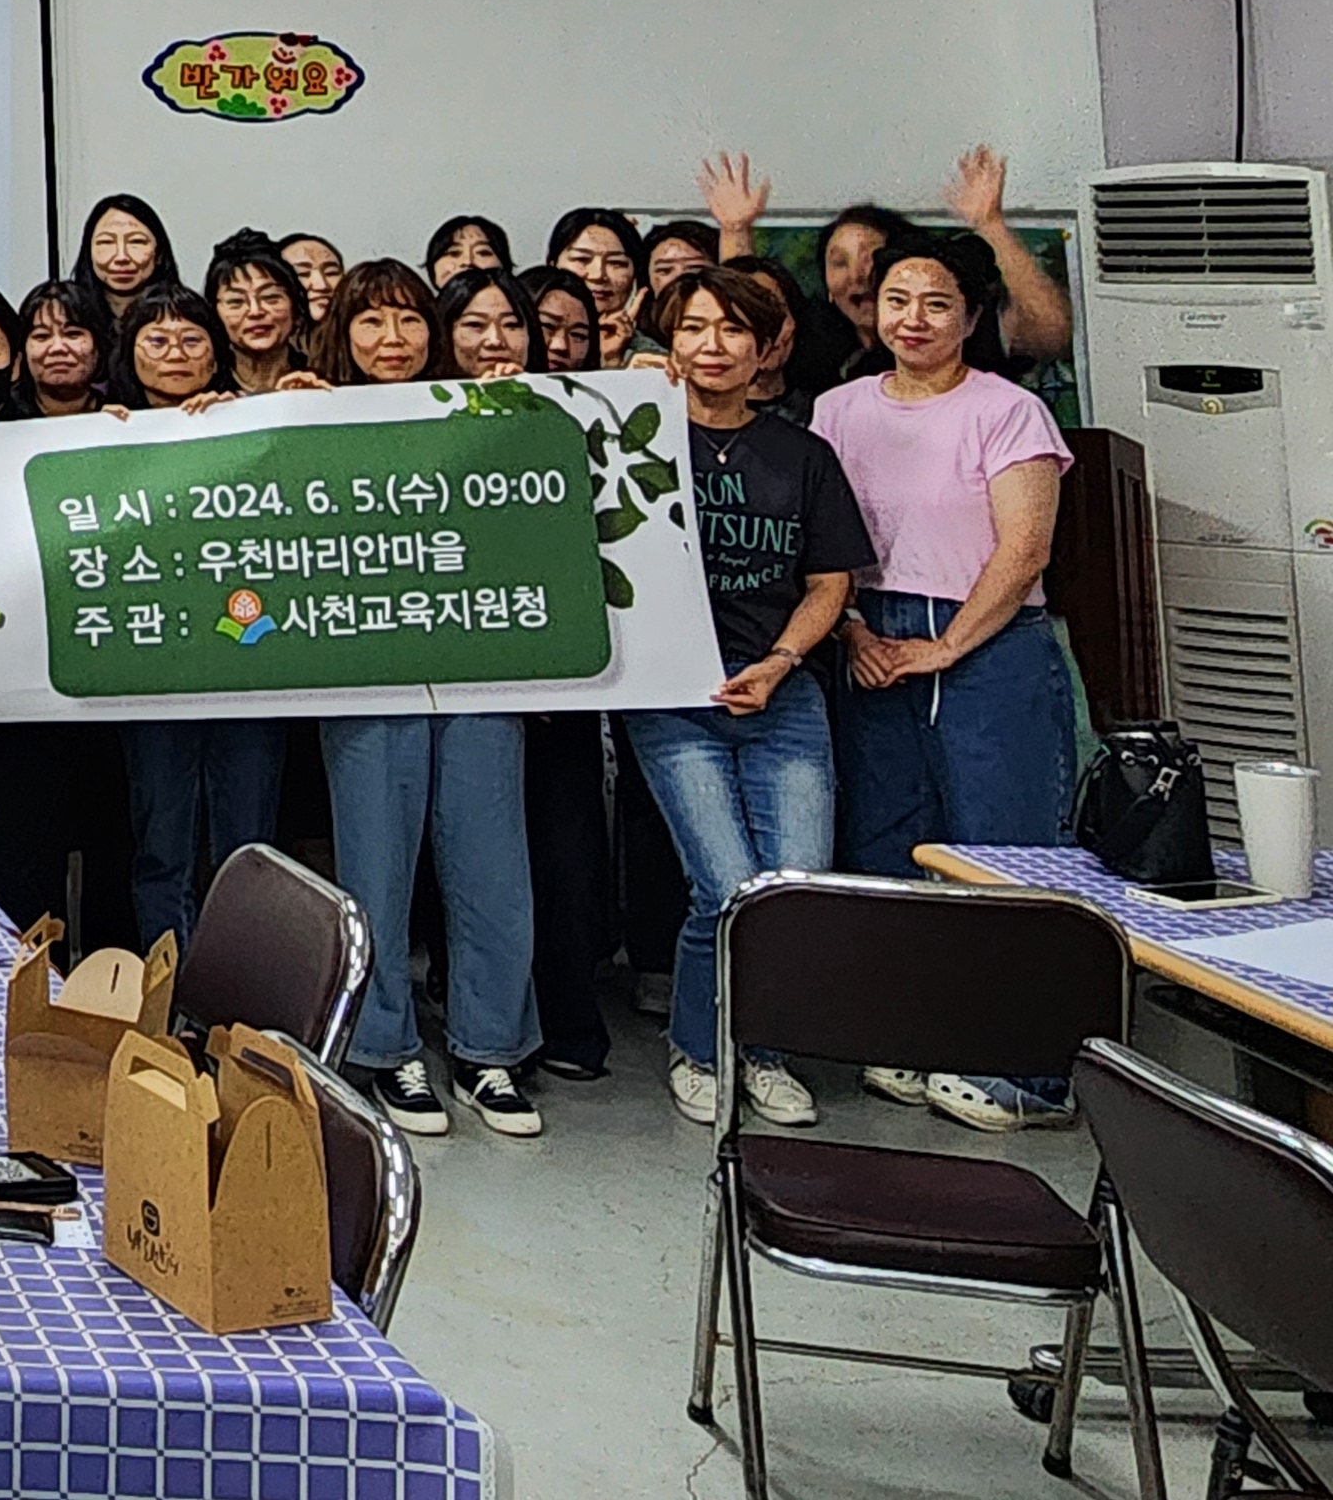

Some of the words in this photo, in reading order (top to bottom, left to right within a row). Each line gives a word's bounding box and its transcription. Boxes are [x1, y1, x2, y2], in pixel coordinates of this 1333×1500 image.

[180, 61, 328, 100] 반가워요
[58, 494, 100, 532] 일
[113, 489, 152, 526] 시
[188, 482, 294, 520] 2024.
[306, 479, 340, 514] 6.
[351, 472, 450, 515] 5.(수)
[463, 469, 566, 508] 09:00
[68, 545, 110, 589] 장
[121, 545, 162, 582] 소
[198, 530, 467, 583] 우천바리안마을
[708, 563, 784, 592] FRANCE
[74, 606, 115, 648] 주
[126, 603, 166, 645] 관
[281, 585, 549, 638] 사천교육지원청
